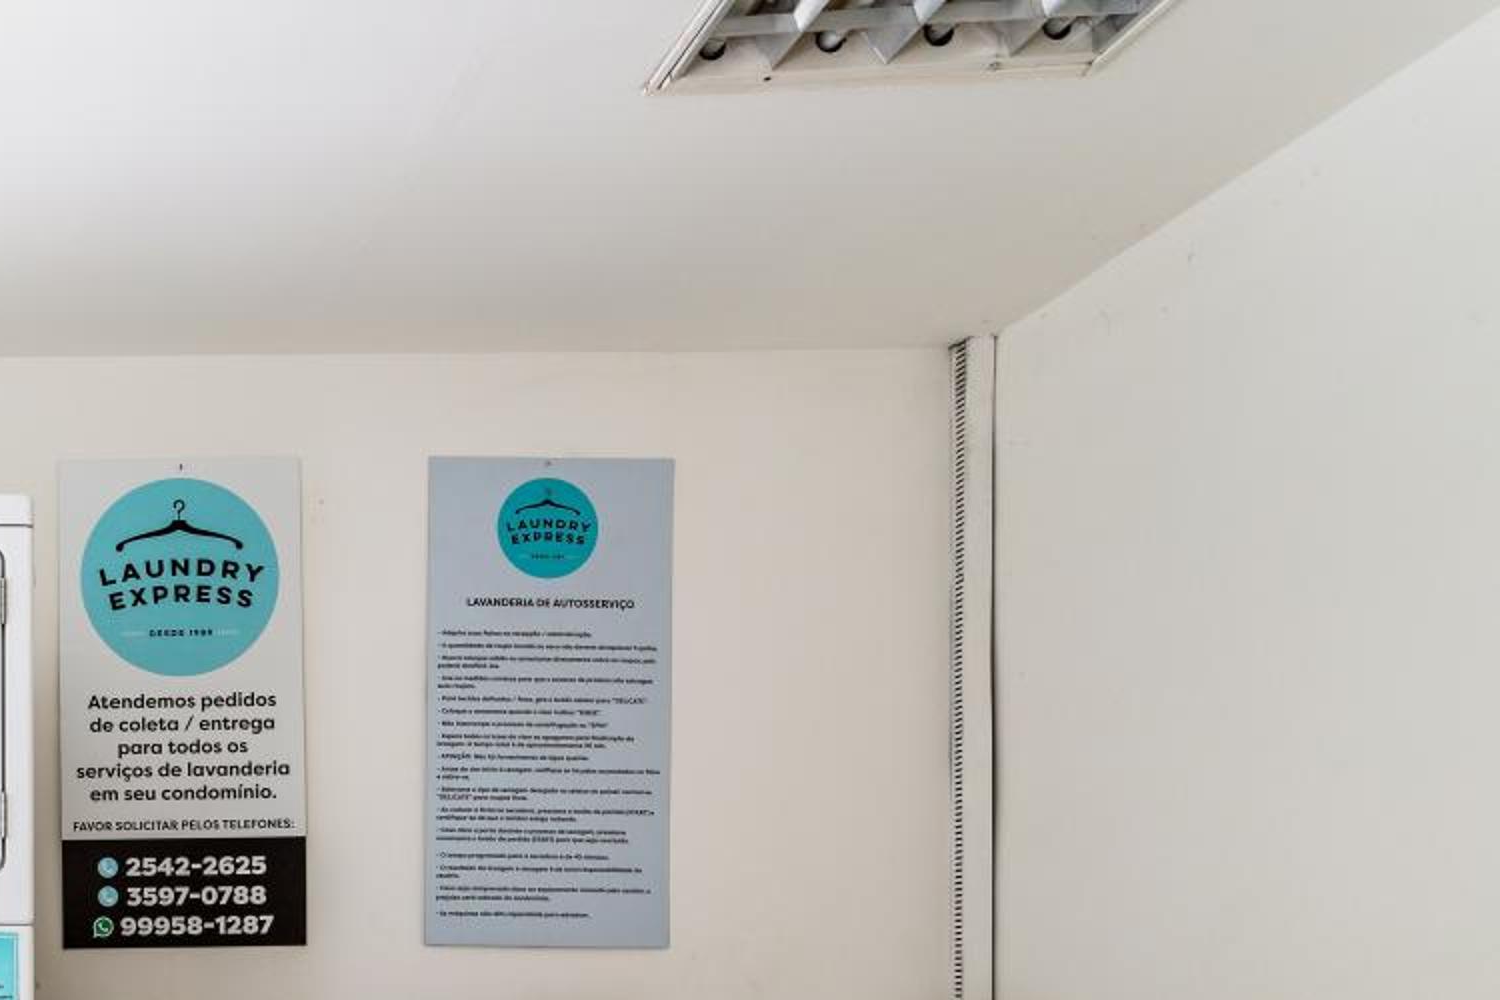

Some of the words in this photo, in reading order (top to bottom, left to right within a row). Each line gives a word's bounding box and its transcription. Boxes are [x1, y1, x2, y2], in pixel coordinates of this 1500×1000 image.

[506, 518, 592, 533] LAUNDRY
[511, 531, 585, 546] EXPRESS
[98, 557, 265, 587] LAUNDRY
[108, 584, 254, 611] EXPRESS
[466, 597, 534, 608] LAVANDERIA
[536, 598, 550, 608] DE
[552, 598, 635, 611] AUTOSSERVIÇO
[87, 693, 196, 710] Atendemos
[200, 691, 277, 712] pedidos
[89, 717, 114, 733] de
[118, 716, 179, 732] coleta
[184, 715, 195, 733] /
[199, 716, 275, 735] entrega
[117, 742, 163, 759] para
[168, 739, 223, 754] todos
[227, 741, 249, 754] os
[76, 763, 153, 782] serviços
[157, 762, 182, 777] de
[187, 760, 291, 777] lavanderia
[89, 789, 119, 802] em
[123, 788, 157, 802] seu
[161, 783, 278, 801] condomínio.
[73, 821, 113, 832] FAVOR
[115, 820, 179, 832] SOLICITAR
[181, 819, 220, 831] PELOS
[222, 818, 295, 830] TELEFONES:
[125, 855, 268, 877] 2542-2625
[126, 885, 268, 907] 3597-0788
[120, 914, 275, 936] 99958-1287
